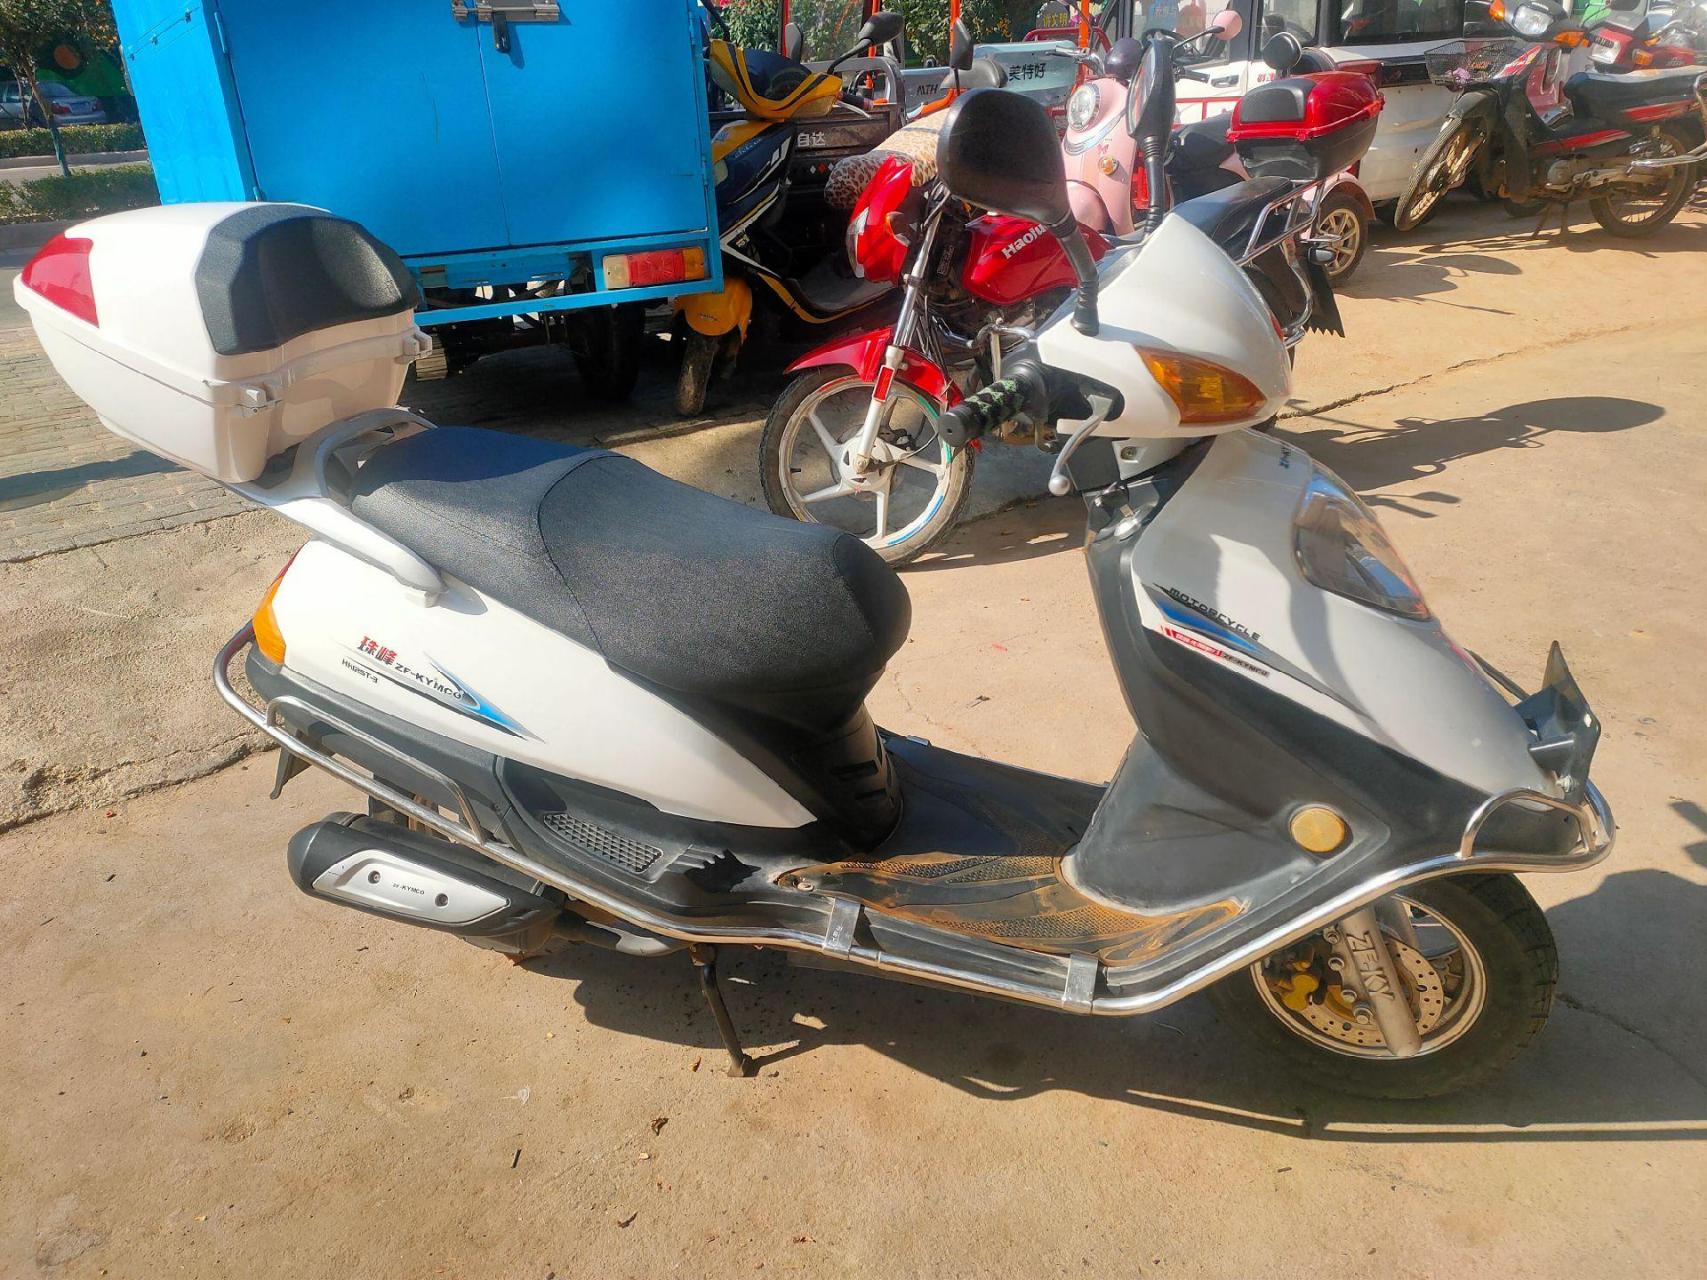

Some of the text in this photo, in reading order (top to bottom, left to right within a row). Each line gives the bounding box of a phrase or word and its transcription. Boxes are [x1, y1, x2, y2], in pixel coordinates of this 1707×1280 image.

[1008, 62, 1047, 82] 美特好
[797, 131, 826, 148] 自达
[1001, 223, 1048, 260] Haoju
[1169, 587, 1261, 641] MOTORCYCLE
[356, 635, 398, 666] 珠峰
